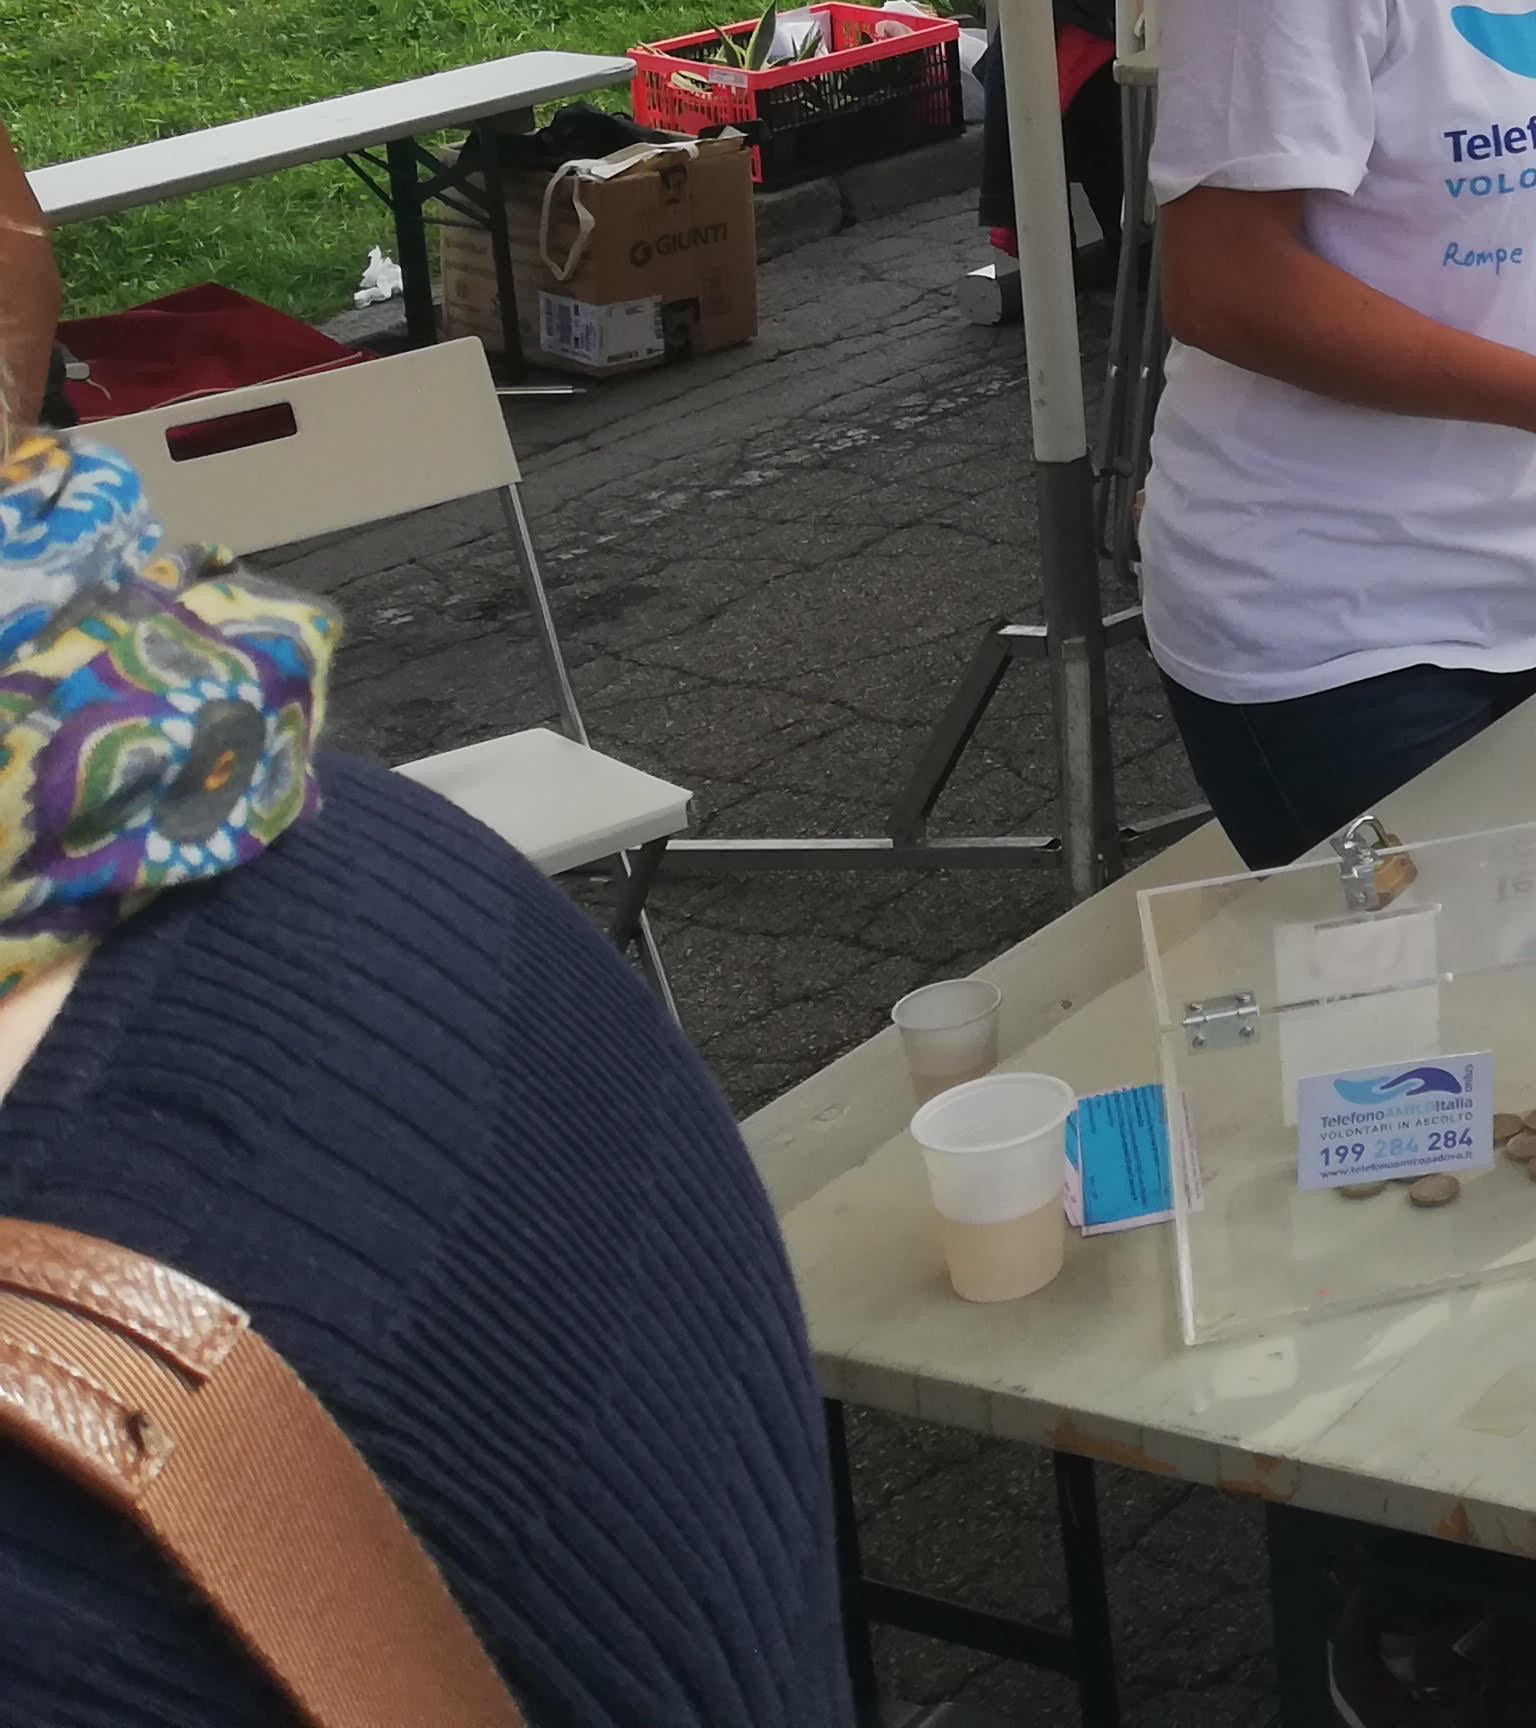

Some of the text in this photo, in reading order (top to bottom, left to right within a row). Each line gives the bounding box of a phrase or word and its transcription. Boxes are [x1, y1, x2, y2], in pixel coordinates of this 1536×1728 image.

[655, 221, 730, 256] GIUNTI
[1442, 241, 1524, 275] Rompe
[1319, 1111, 1473, 1142] VOLONTARI IN ASCOLTO
[1320, 1127, 1473, 1167] 199 284 284
